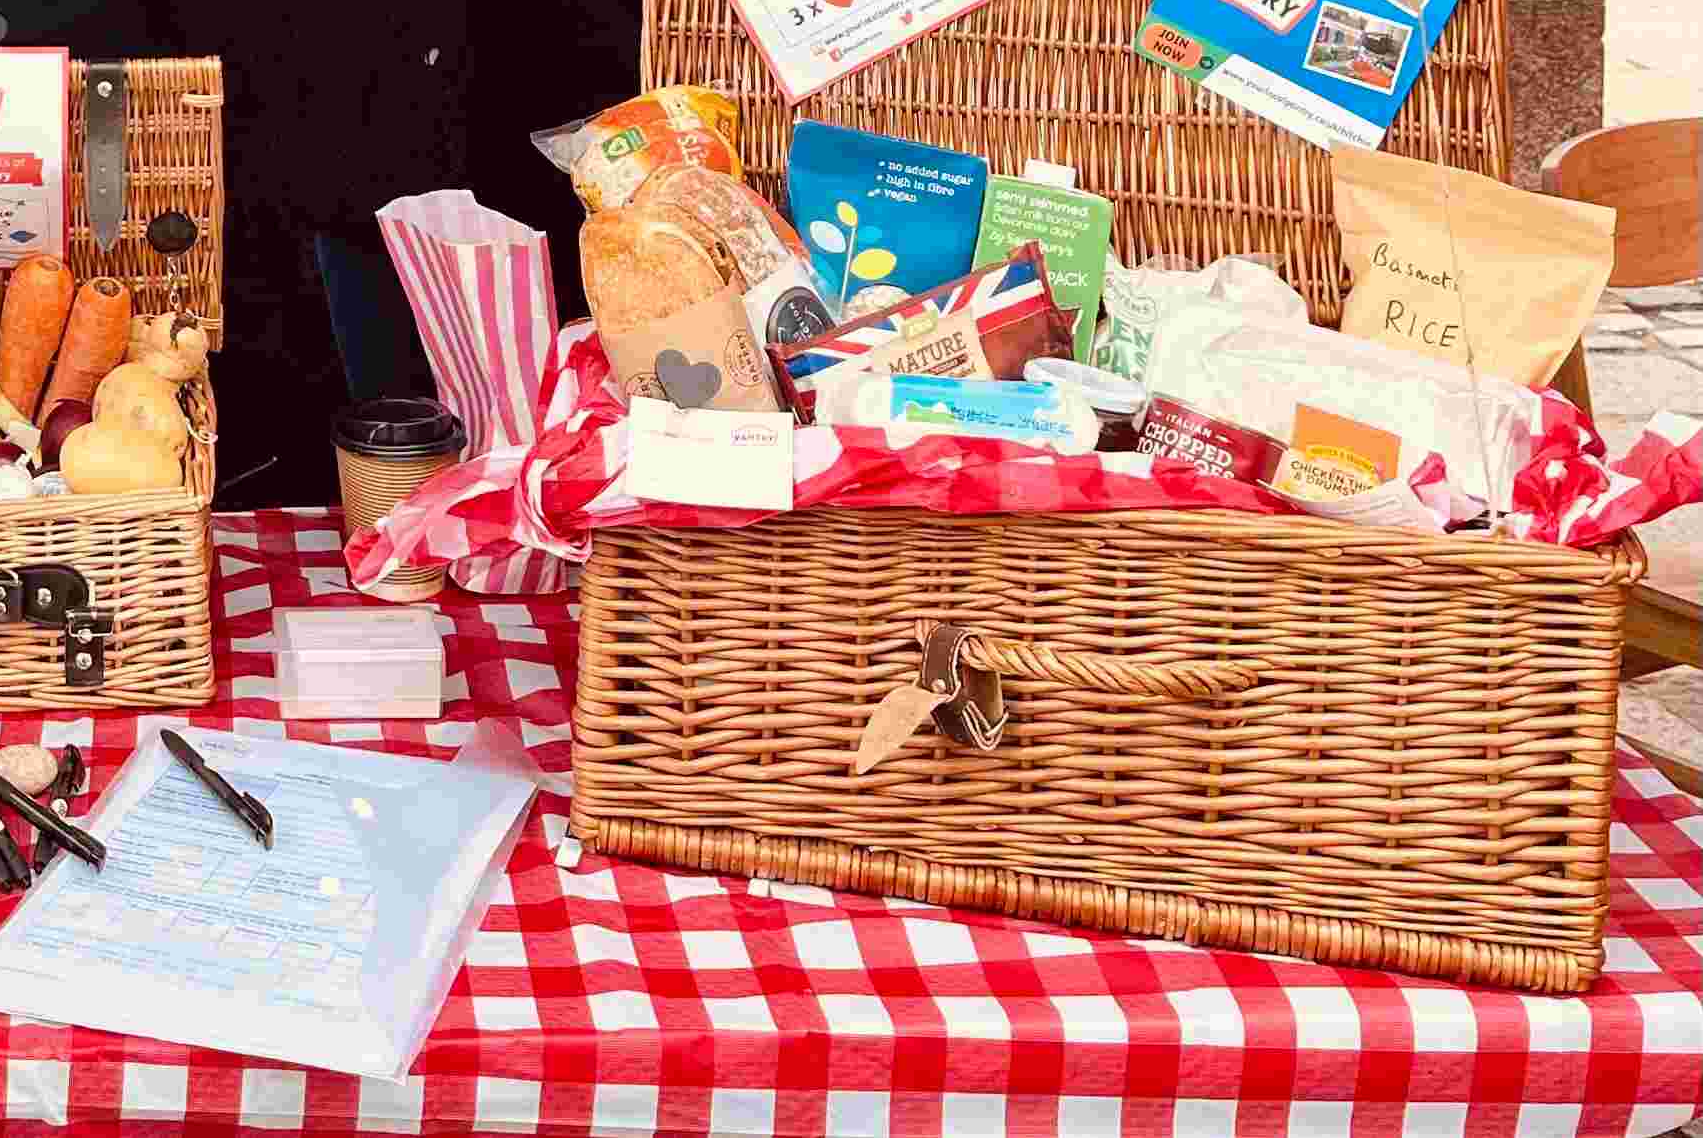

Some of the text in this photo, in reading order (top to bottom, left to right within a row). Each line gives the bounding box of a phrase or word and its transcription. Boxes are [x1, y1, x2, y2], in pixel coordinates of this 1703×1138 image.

[788, 0, 824, 26] 3 x
[1157, 27, 1190, 49] JOIN
[1153, 41, 1186, 64] NOW
[885, 173, 955, 197] high in fibre
[888, 161, 974, 186] no added sugar
[884, 188, 918, 204] vegan
[1385, 300, 1459, 347] RICE
[889, 331, 967, 375] MATURE
[1166, 413, 1213, 439] ITALIAN
[1145, 421, 1233, 468] CHOPPED
[1290, 460, 1347, 485] CHICKEN
